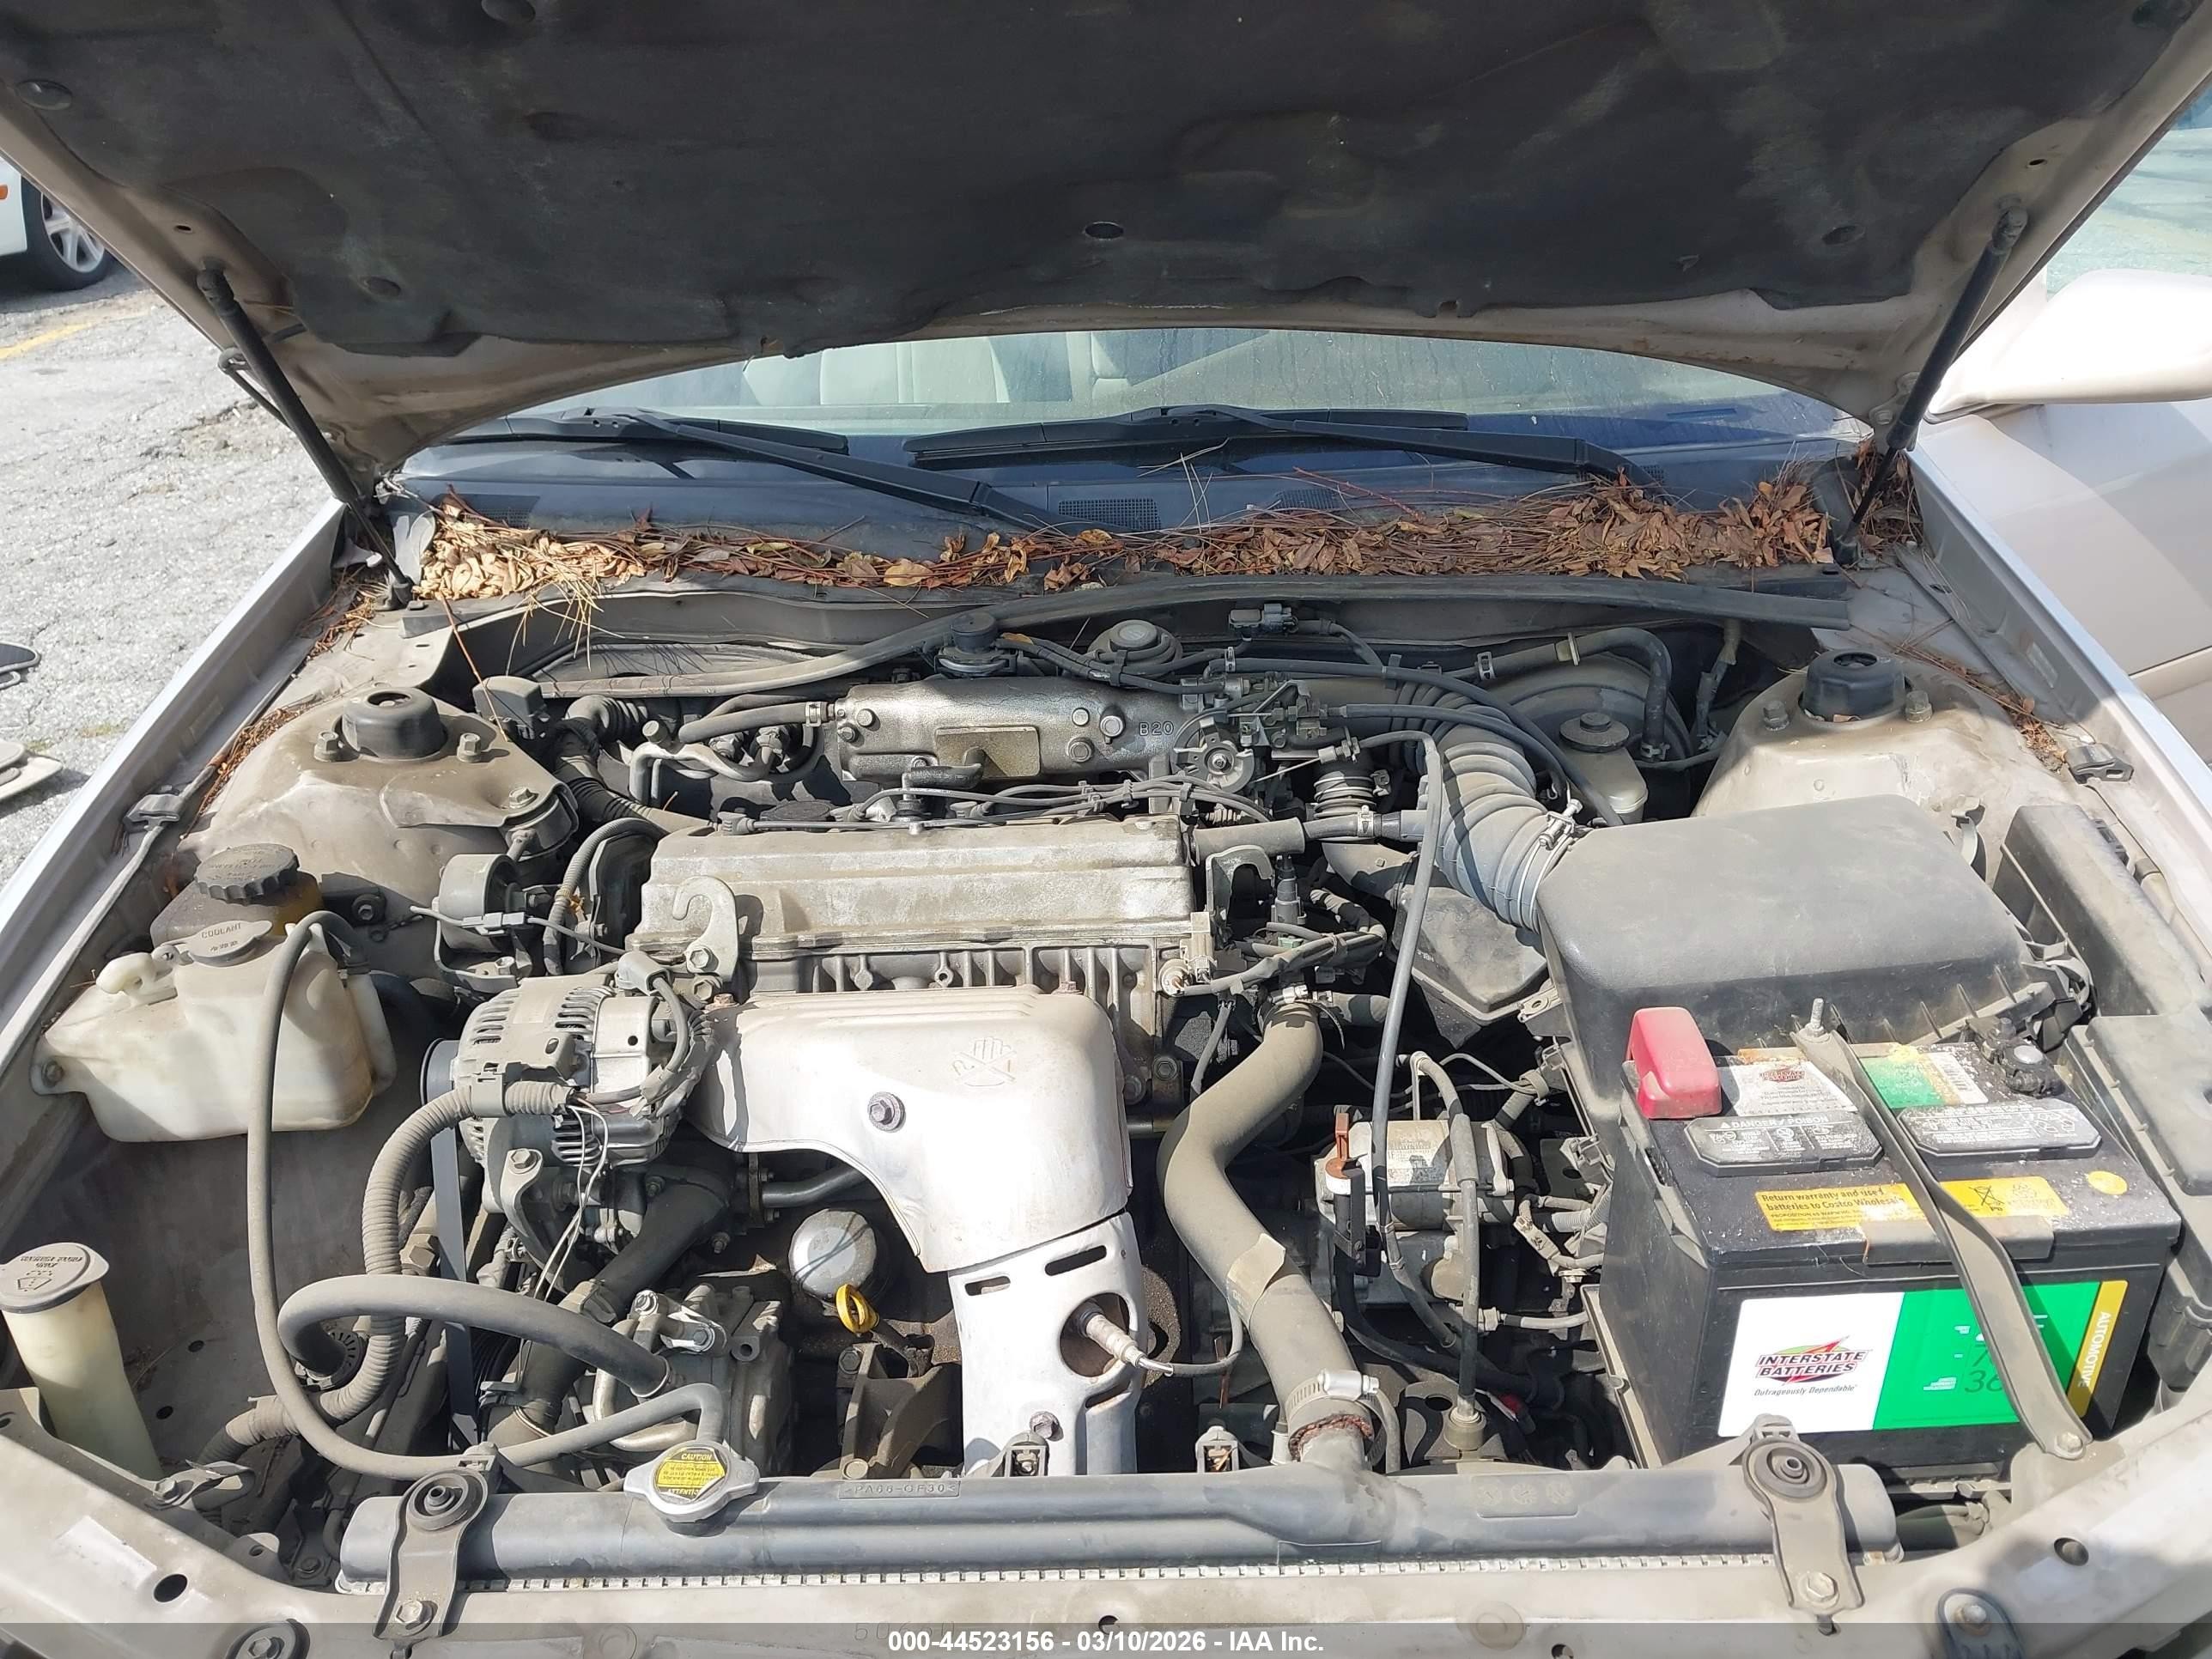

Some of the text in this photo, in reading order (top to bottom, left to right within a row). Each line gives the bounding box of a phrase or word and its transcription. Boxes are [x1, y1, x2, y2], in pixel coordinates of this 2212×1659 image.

[1139, 720, 1174, 737] B20
[201, 923, 241, 939] COOLANT
[1731, 1119, 1777, 1128] DANGER
[1787, 1115, 1829, 1125] POISON
[1796, 1192, 1838, 1200] warranty
[1861, 1187, 1884, 1196] used
[1822, 1200, 1853, 1208] Costco
[2079, 1311, 2112, 1388] AUTOMOTIVE
[1758, 1352, 1867, 1365] INTERSTATE
[1759, 1363, 1856, 1376] BATTERIES
[1753, 1388, 1806, 1397] Outrageously
